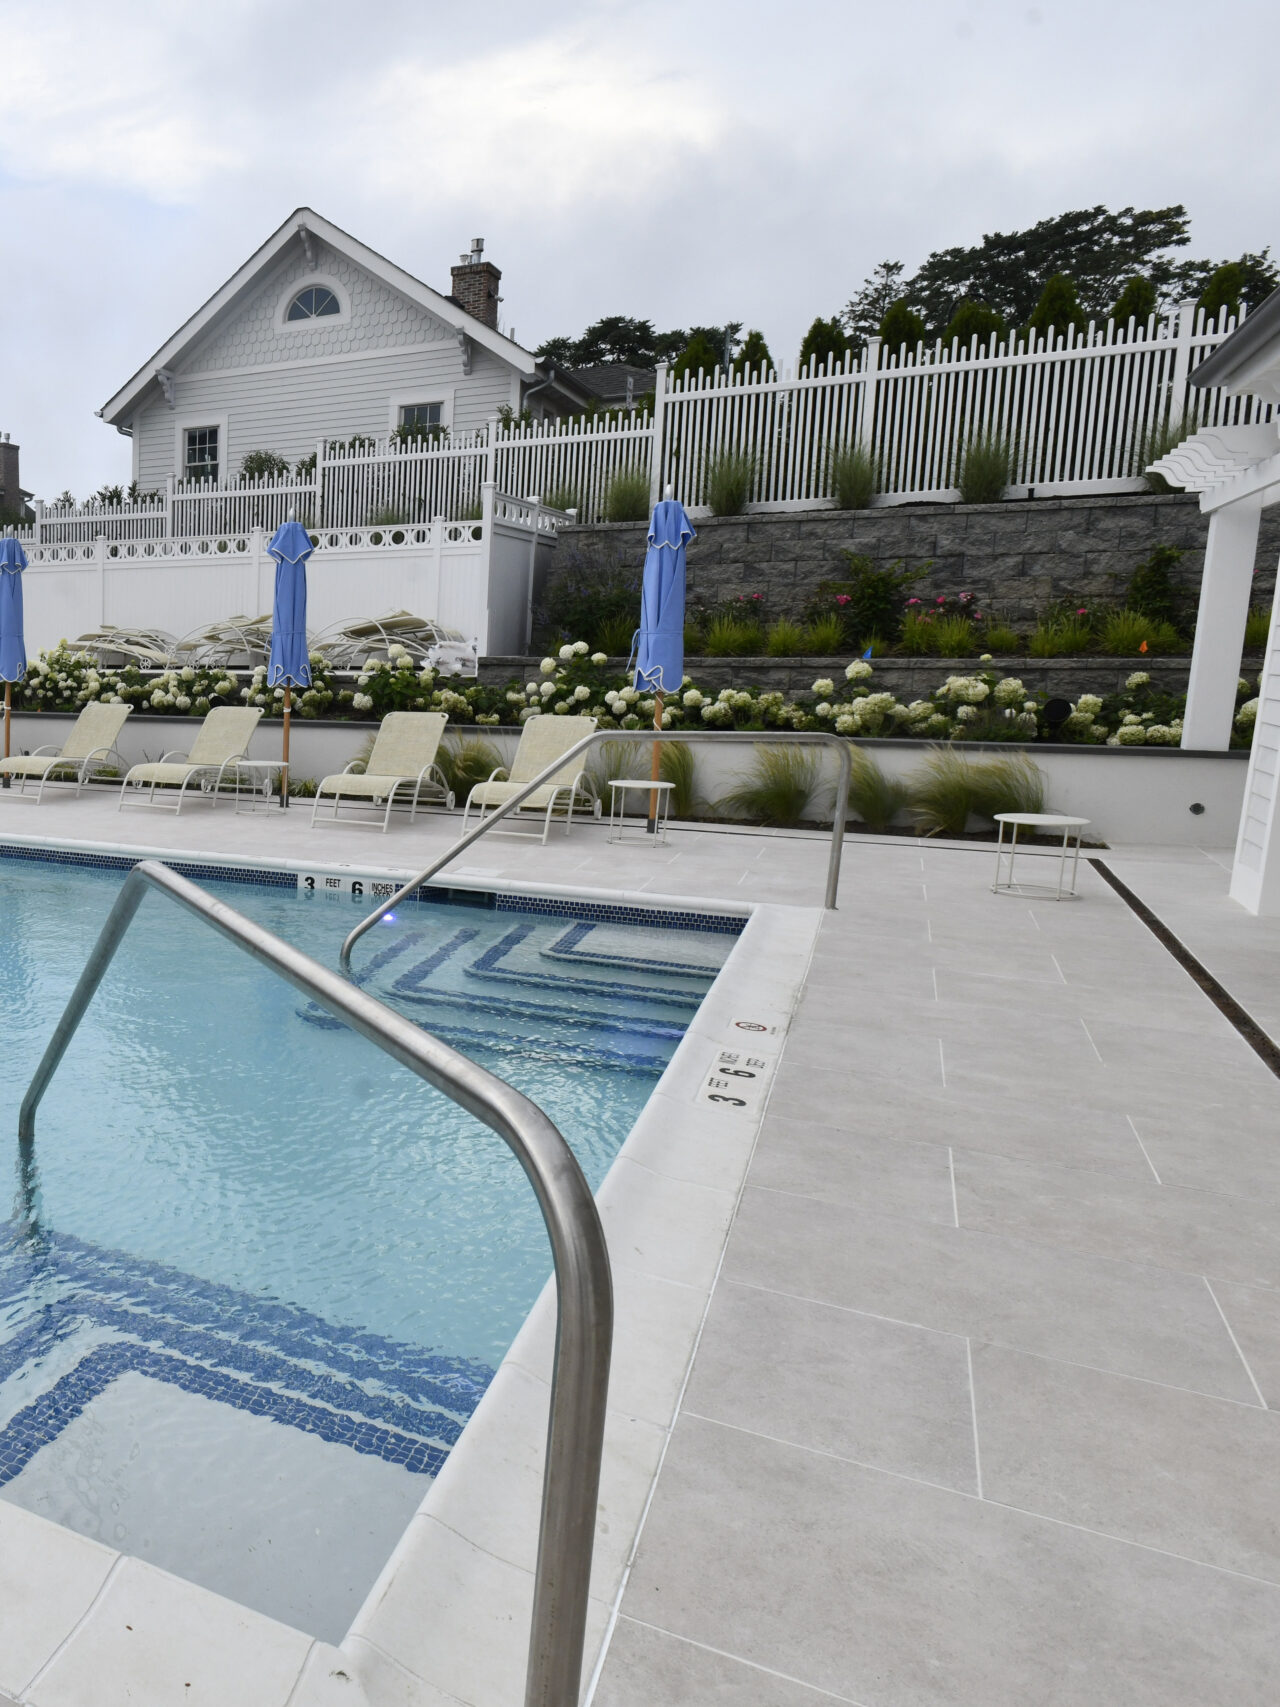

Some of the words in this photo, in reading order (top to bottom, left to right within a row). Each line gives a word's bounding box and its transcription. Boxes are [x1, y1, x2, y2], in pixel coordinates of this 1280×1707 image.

[304, 876, 315, 890] 3
[325, 877, 341, 888] FEET
[351, 881, 363, 894] 6
[372, 882, 393, 894] INCHES
[719, 1068, 756, 1079] 6
[708, 1077, 729, 1090] FEET
[707, 1094, 747, 1107] 3
